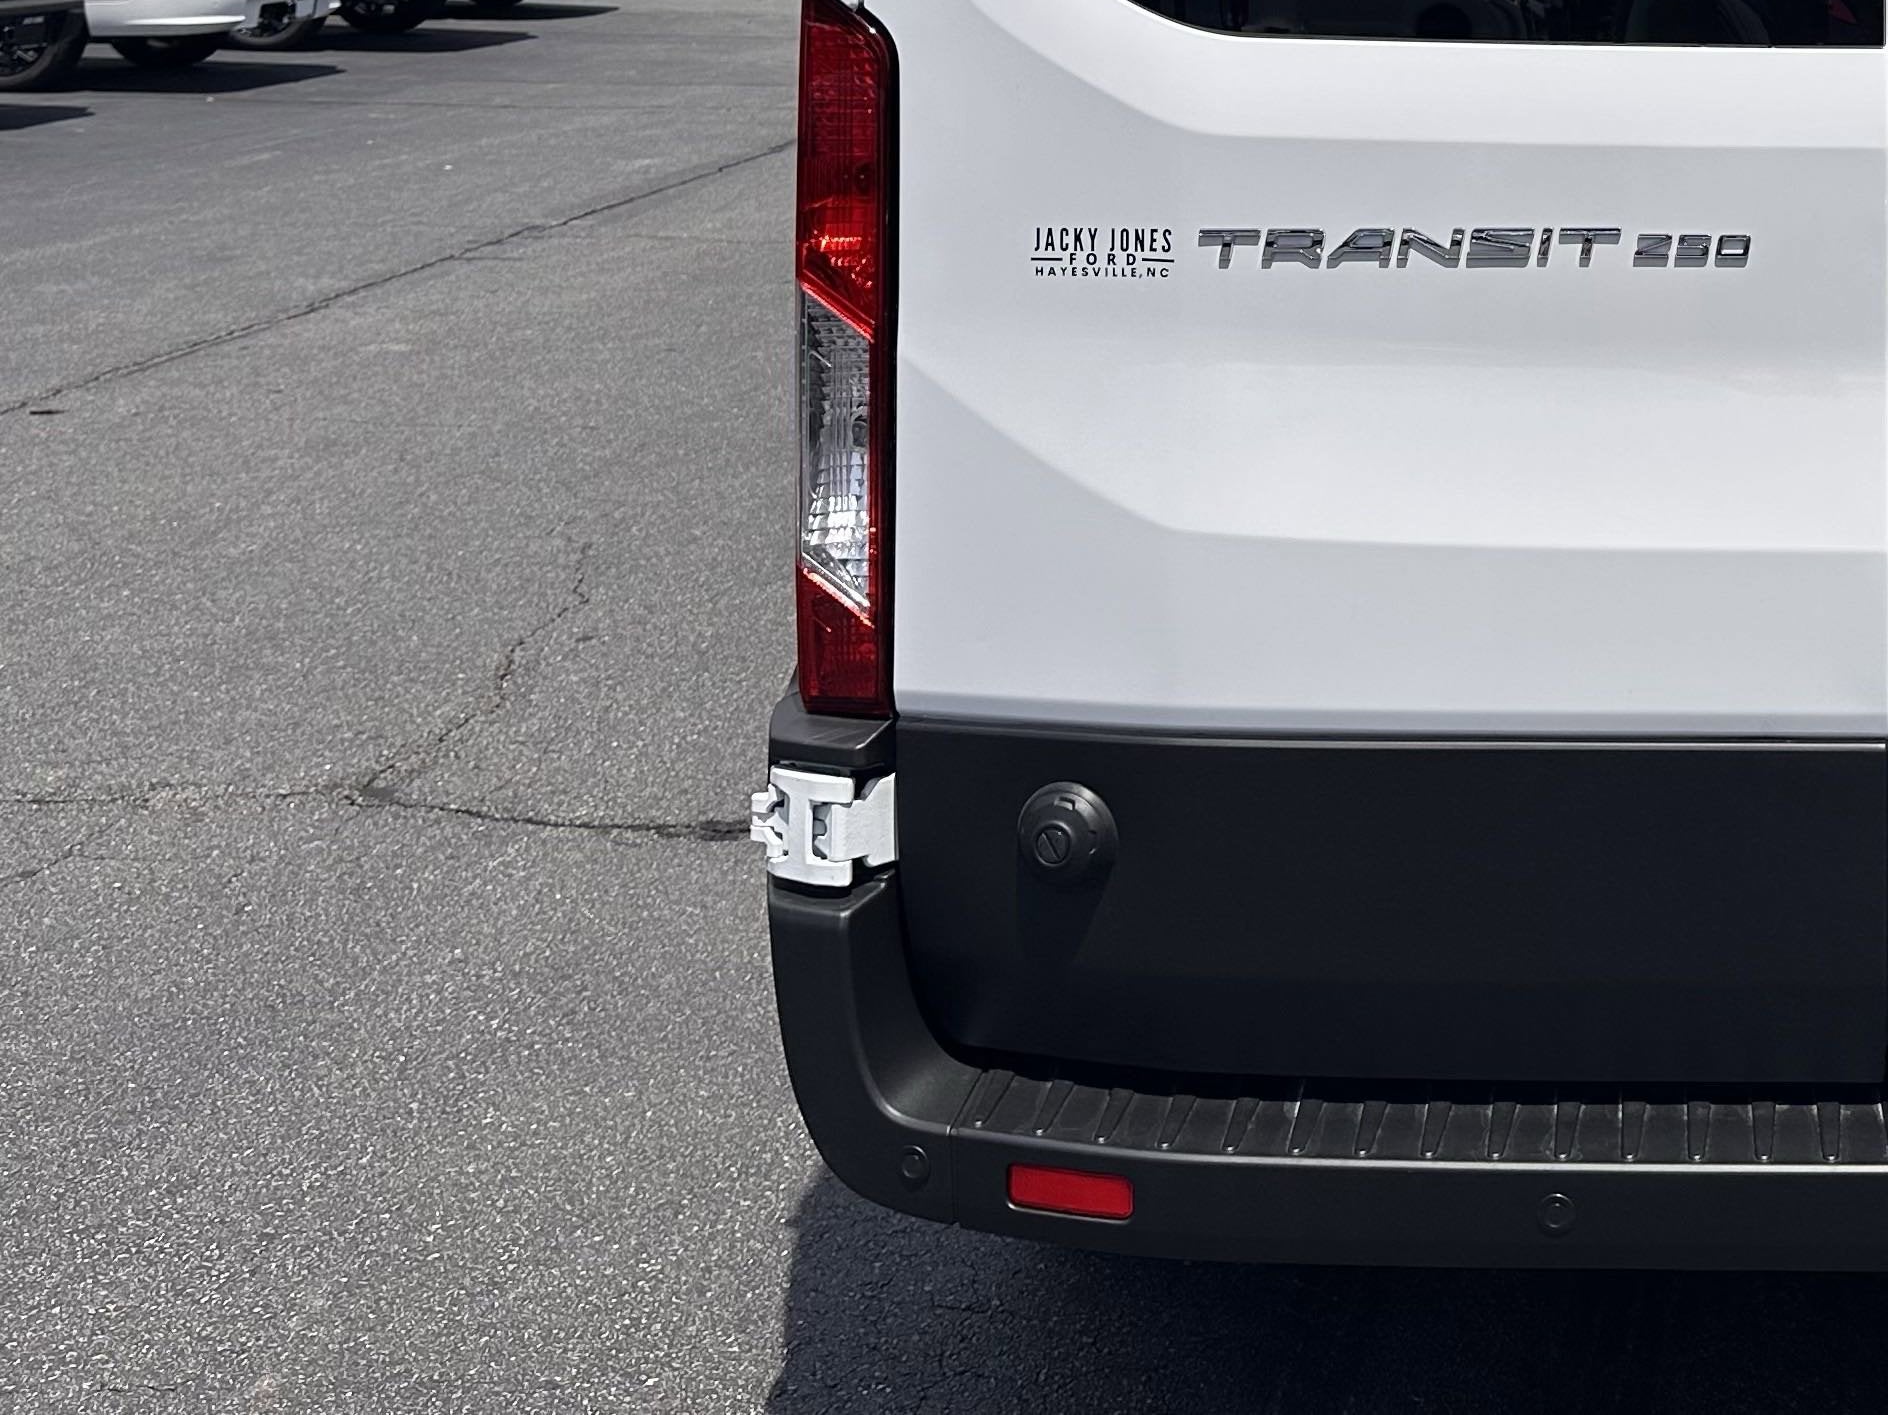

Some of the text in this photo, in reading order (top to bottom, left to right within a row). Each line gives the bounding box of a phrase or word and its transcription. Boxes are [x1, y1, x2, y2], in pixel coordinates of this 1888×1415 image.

[1034, 227, 1172, 253] JACKY JONES
[1198, 226, 1752, 270] TRANSIT 250
[1069, 252, 1137, 266] FORD
